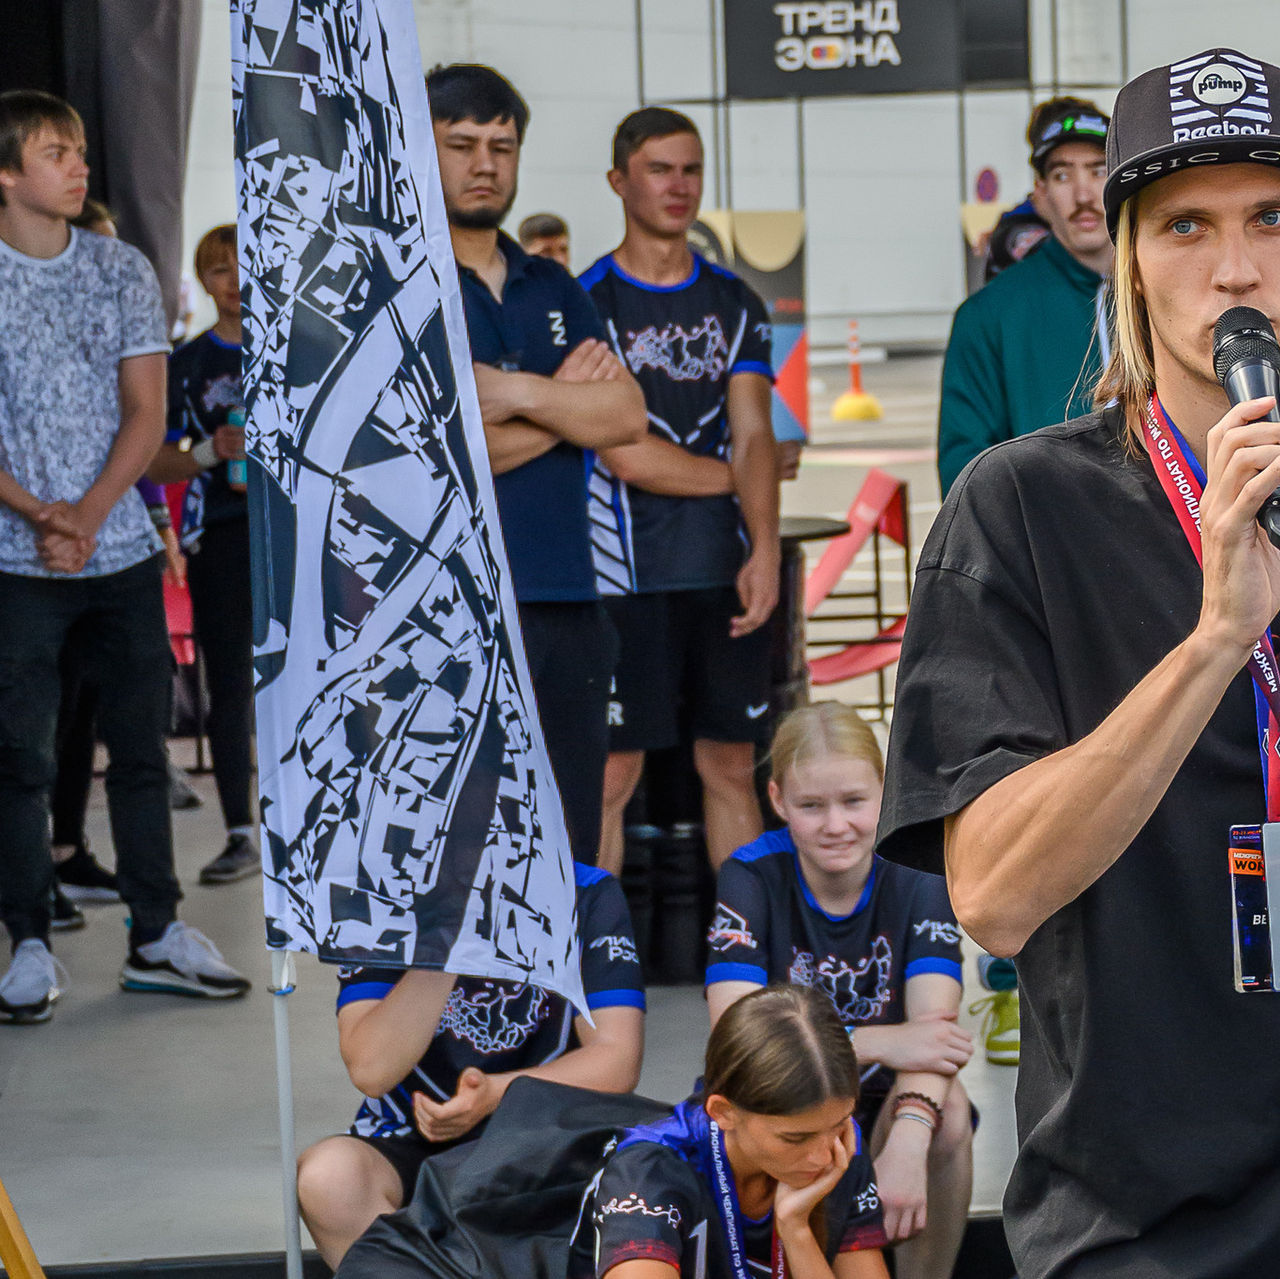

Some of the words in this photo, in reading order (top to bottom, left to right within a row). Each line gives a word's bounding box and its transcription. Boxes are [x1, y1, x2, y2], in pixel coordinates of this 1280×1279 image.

[774, 37, 900, 71] ЗОНА
[1198, 74, 1243, 95] pump
[1157, 439, 1174, 461] ПО
[1166, 460, 1202, 537] ЕМПИОНАТ
